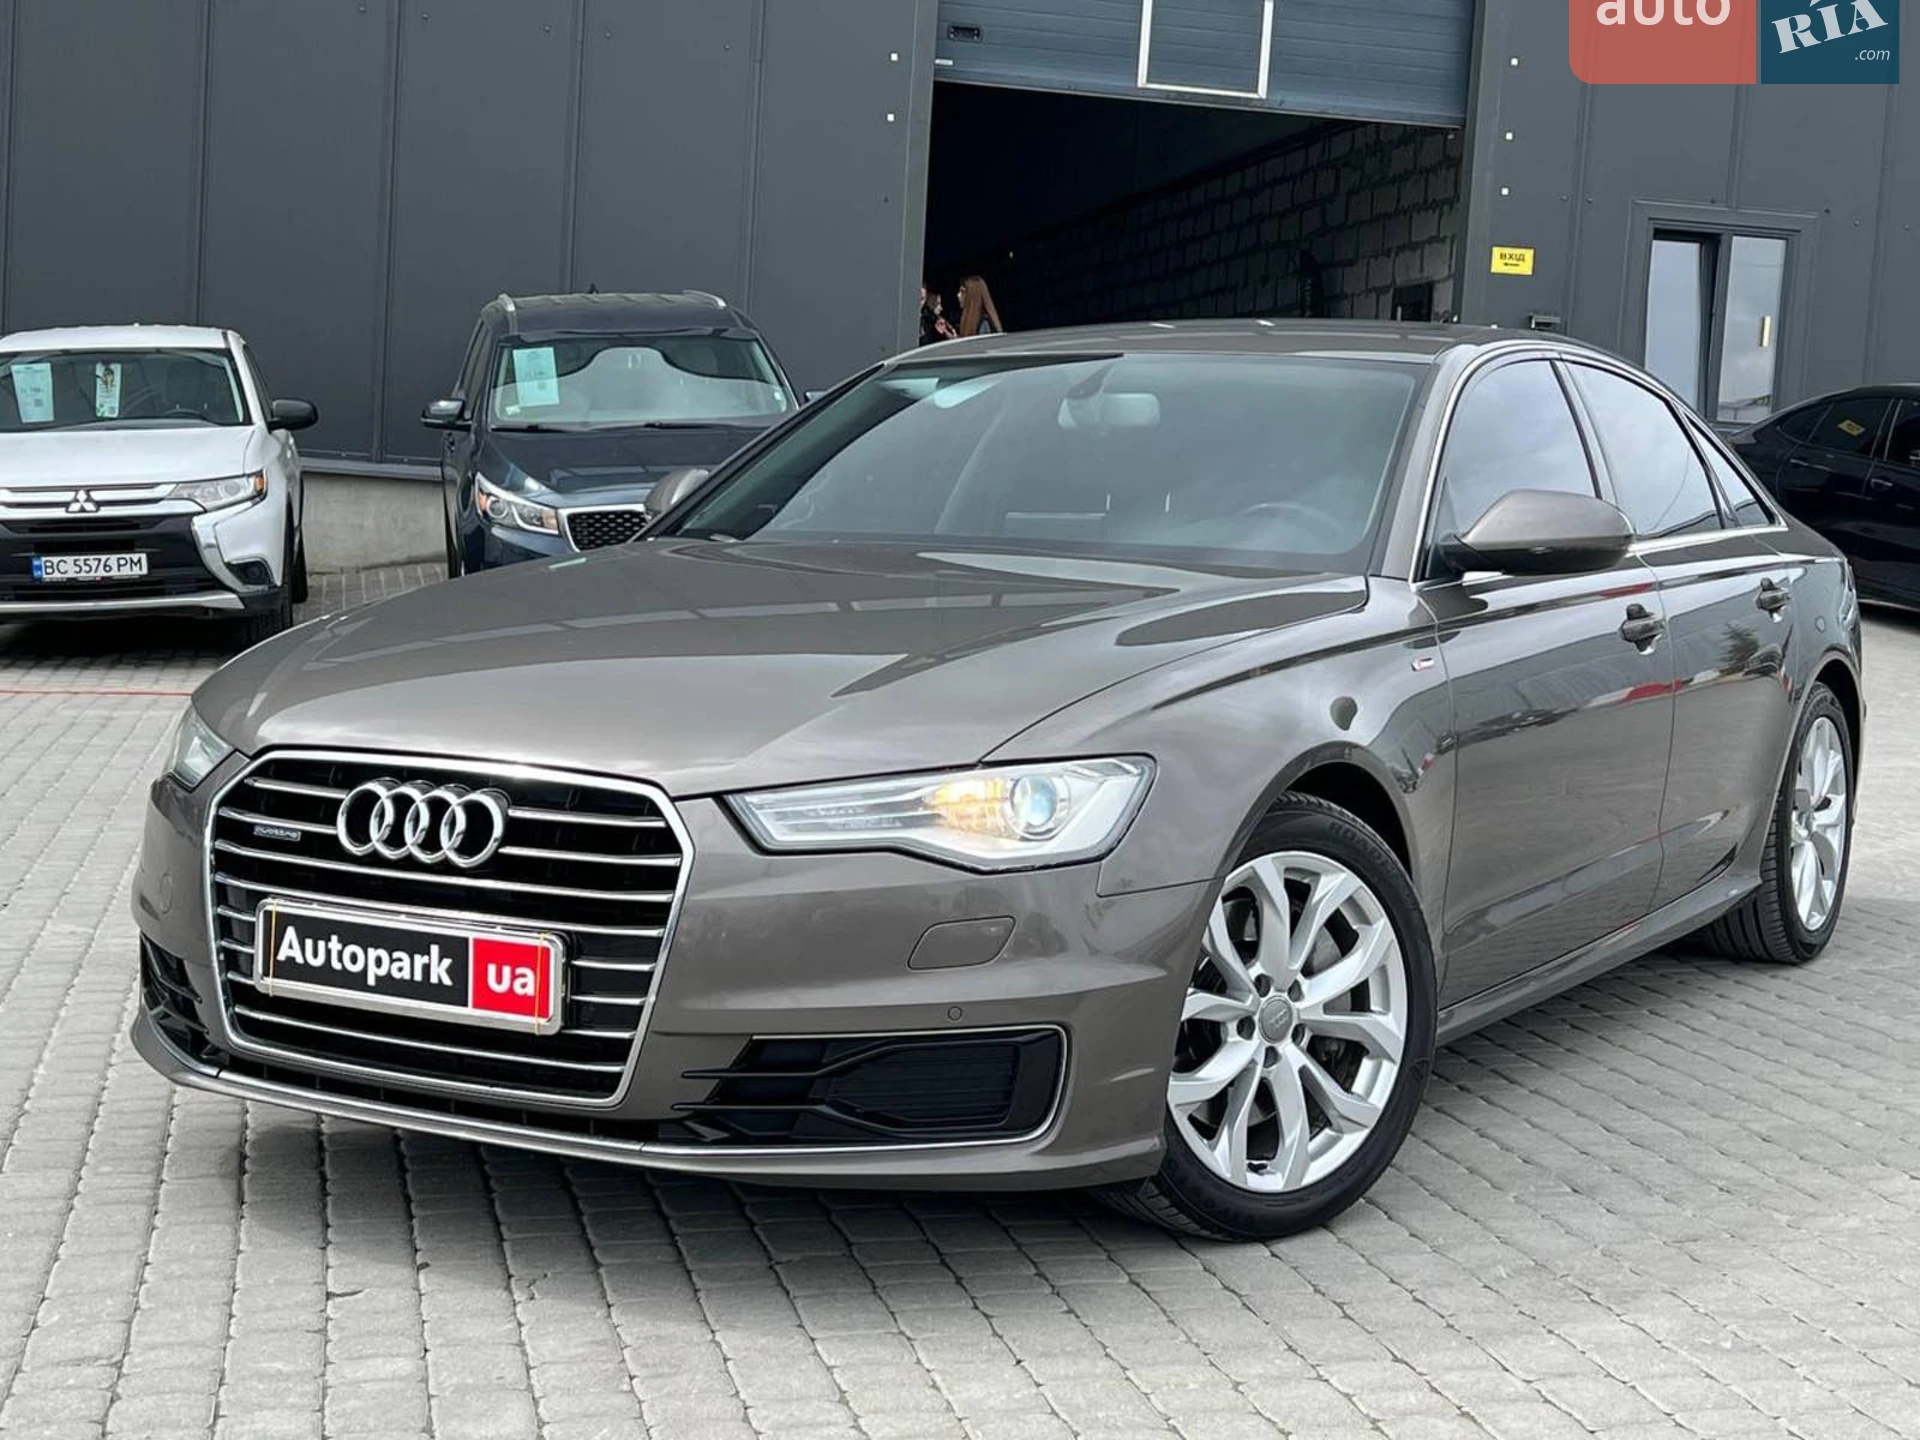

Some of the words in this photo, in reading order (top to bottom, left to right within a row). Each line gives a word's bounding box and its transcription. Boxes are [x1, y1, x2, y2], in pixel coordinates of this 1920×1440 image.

[43, 559, 68, 575] BC
[73, 557, 113, 574] 5576
[116, 556, 143, 573] PM
[276, 926, 453, 986] Autopark
[486, 961, 537, 997] ua
